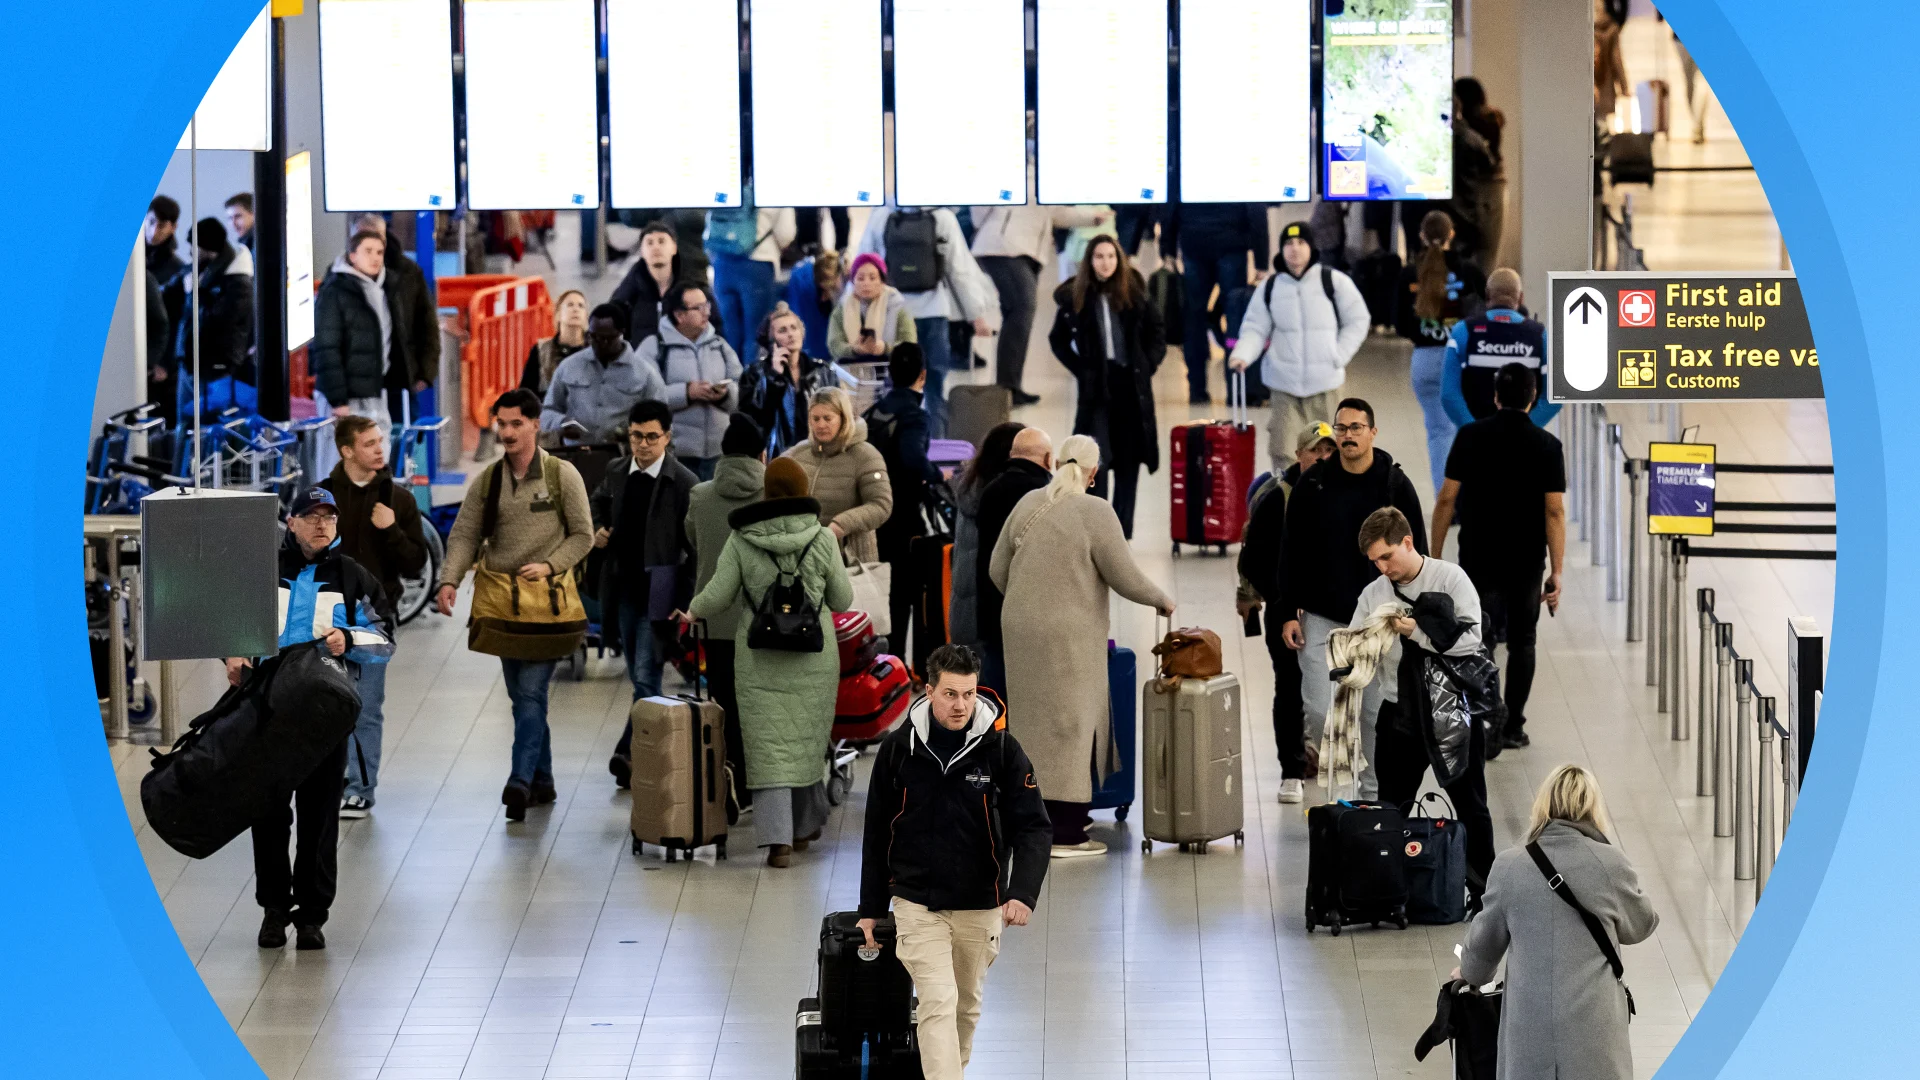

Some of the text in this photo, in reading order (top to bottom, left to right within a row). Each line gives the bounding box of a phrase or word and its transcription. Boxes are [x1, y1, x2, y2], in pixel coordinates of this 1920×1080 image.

[1666, 282, 1781, 306] First aid
[1666, 312, 1766, 331] Eerste hulp
[1477, 340, 1534, 357] Security
[1665, 344, 1713, 367] Tax
[1723, 343, 1780, 367] free
[1666, 373, 1740, 389] Customs
[1656, 466, 1705, 477] PREMIUM
